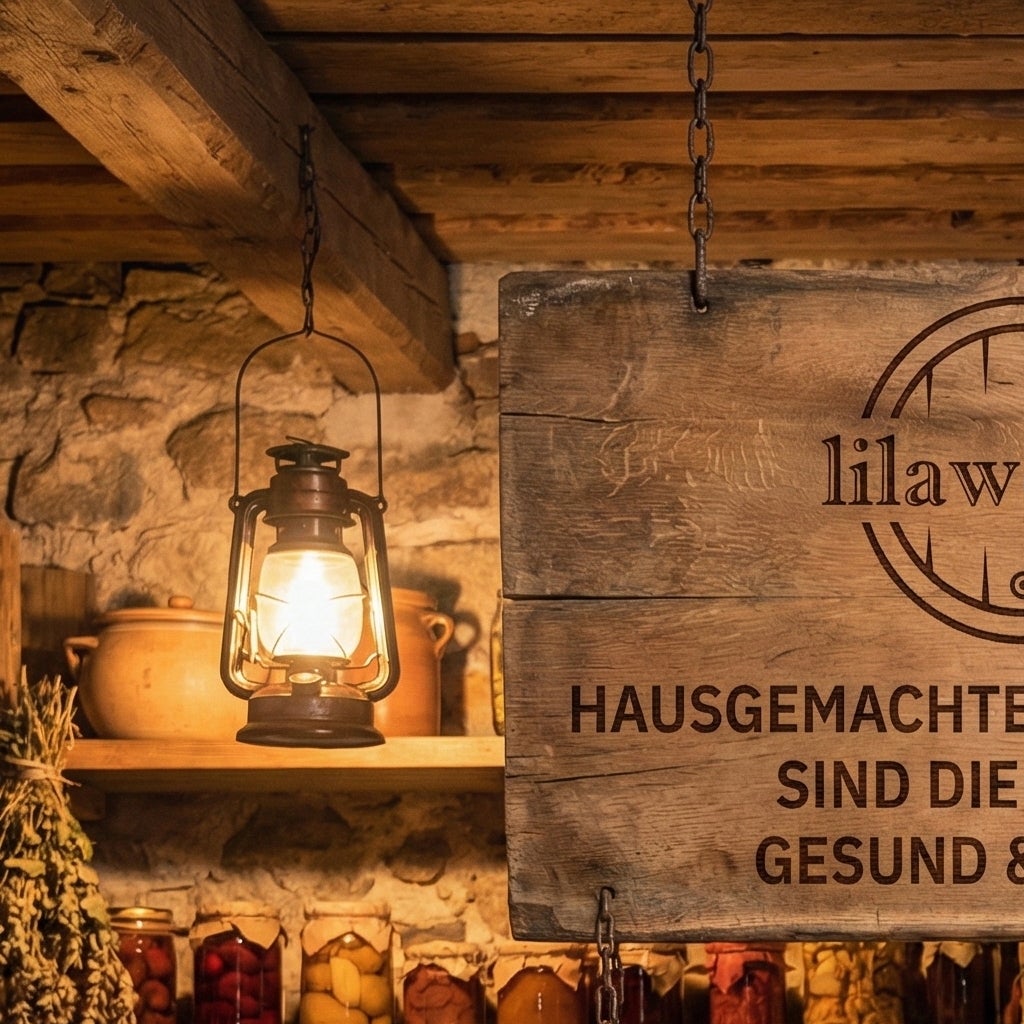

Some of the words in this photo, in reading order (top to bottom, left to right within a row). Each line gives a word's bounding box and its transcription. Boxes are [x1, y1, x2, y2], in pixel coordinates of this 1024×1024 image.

[776, 759, 910, 809] SIND
[930, 759, 1016, 809] DIE
[755, 835, 987, 885] GESUND
